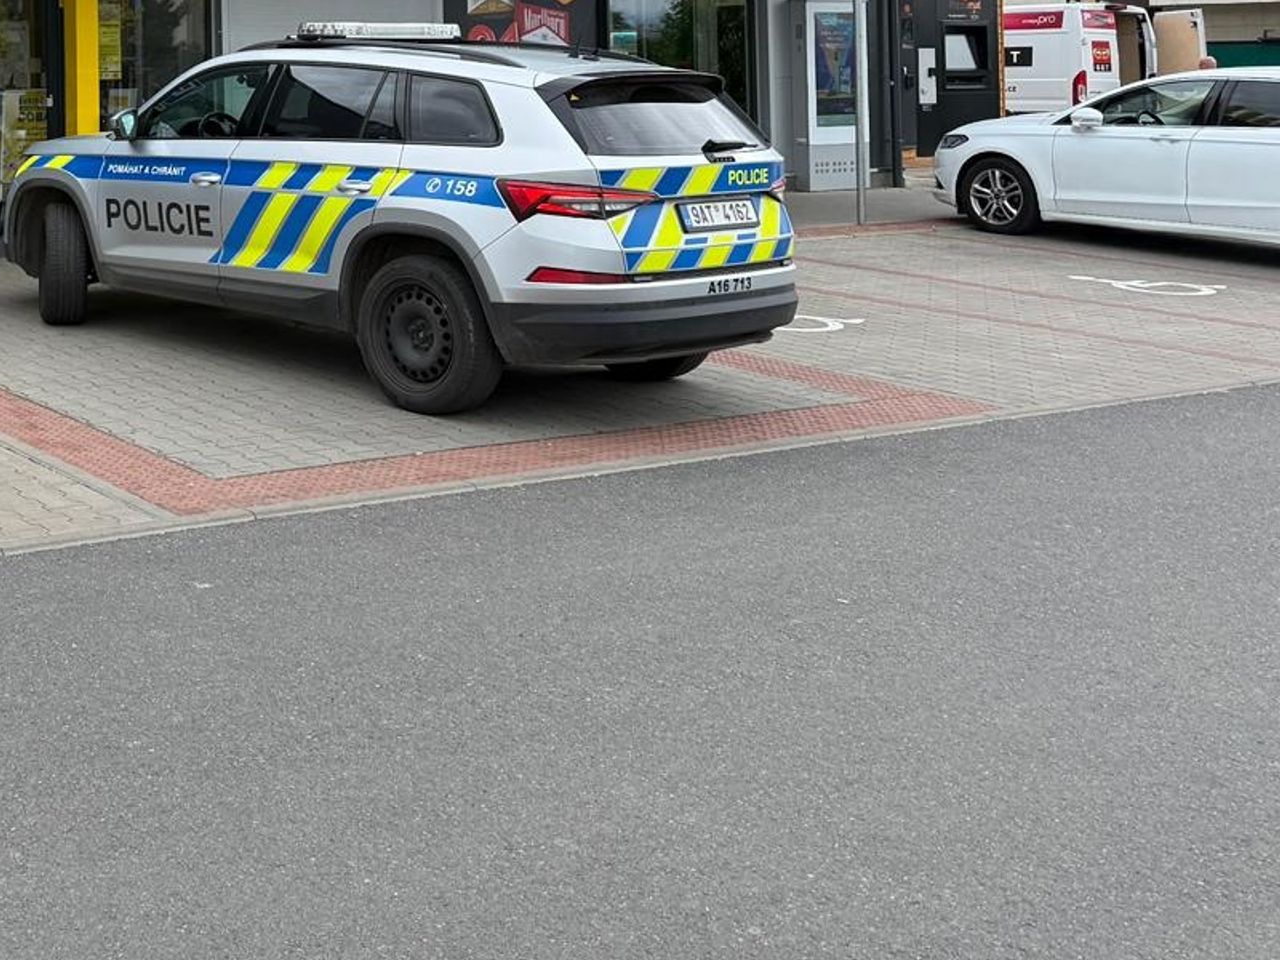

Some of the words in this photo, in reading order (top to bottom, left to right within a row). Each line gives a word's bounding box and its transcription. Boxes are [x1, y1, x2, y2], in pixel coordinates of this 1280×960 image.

[107, 162, 144, 174] POMÁHAT
[144, 165, 150, 174] A
[151, 164, 186, 176] CHRÁNIT
[728, 168, 769, 186] POLICIE
[445, 179, 477, 196] 158
[106, 198, 213, 237] POLICIE
[708, 280, 730, 294] A16
[732, 277, 752, 291] 713
